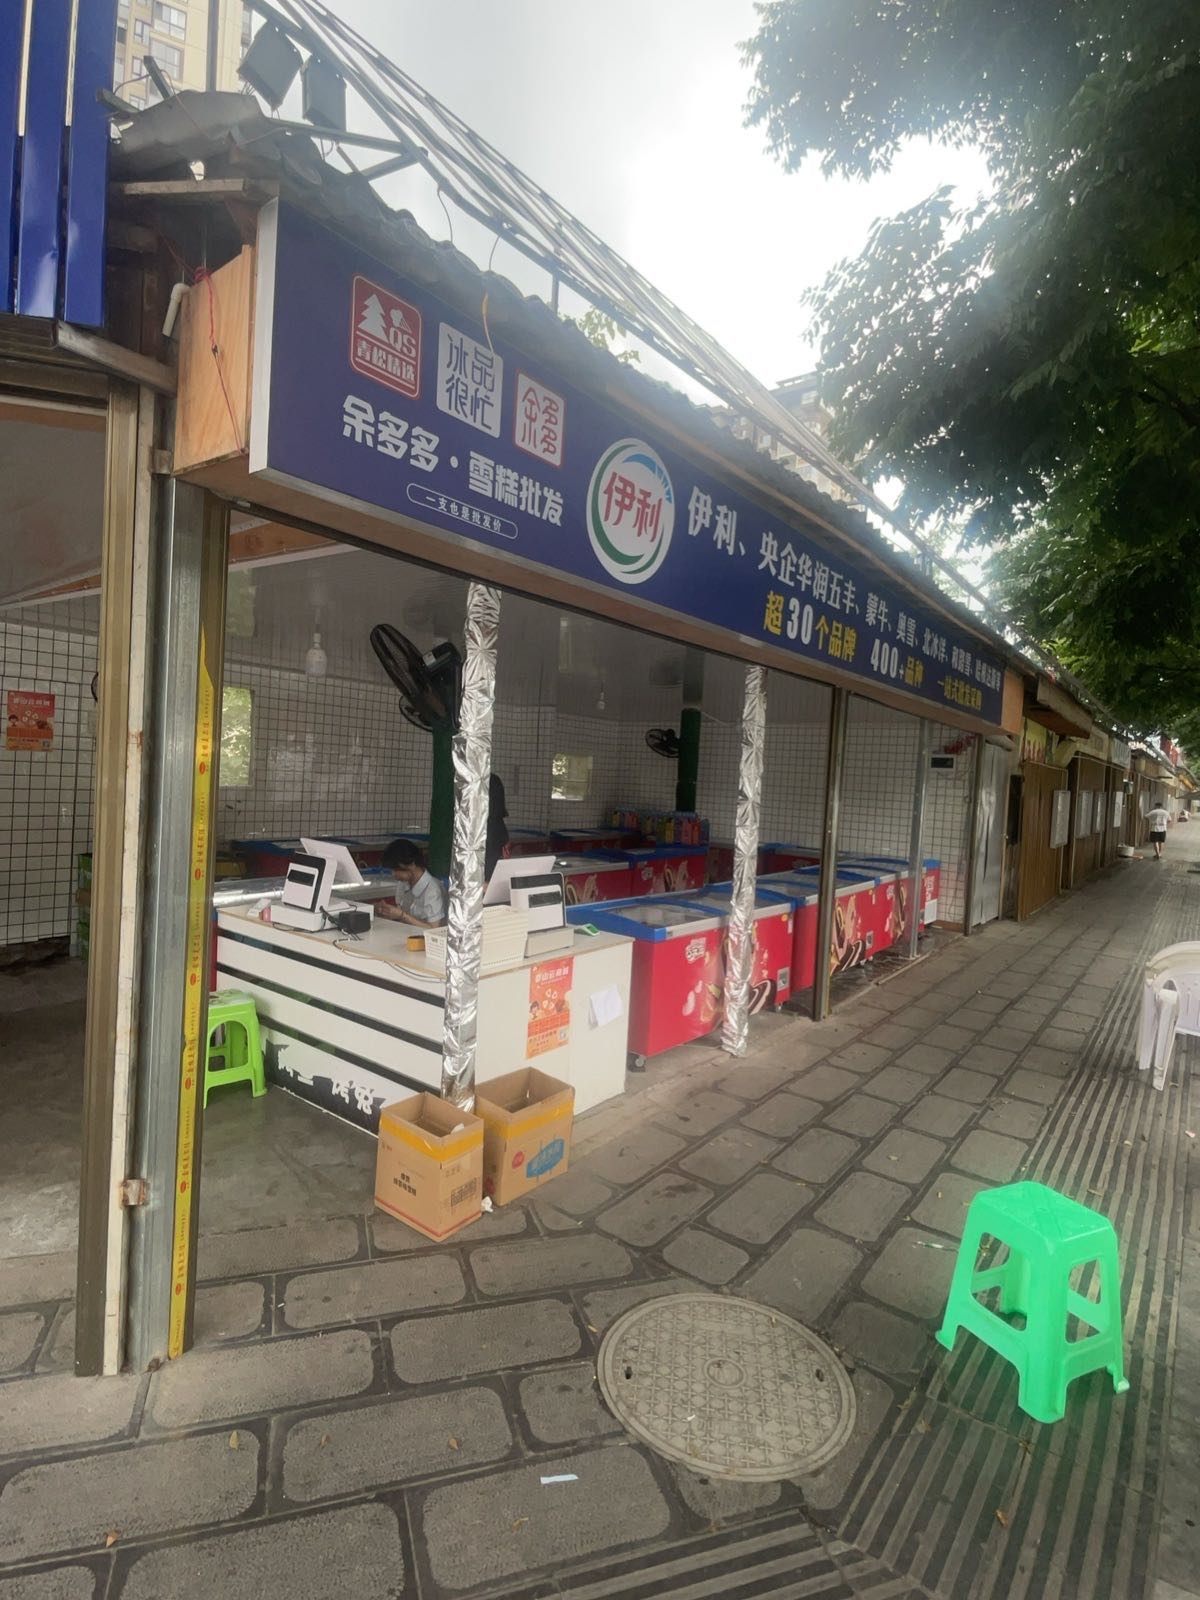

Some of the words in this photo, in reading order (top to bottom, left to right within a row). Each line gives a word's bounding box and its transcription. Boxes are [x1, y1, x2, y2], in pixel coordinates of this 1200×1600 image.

[389, 327, 416, 358] QS
[425, 496, 502, 533] 一支也是批发价
[603, 472, 662, 543] 伊利
